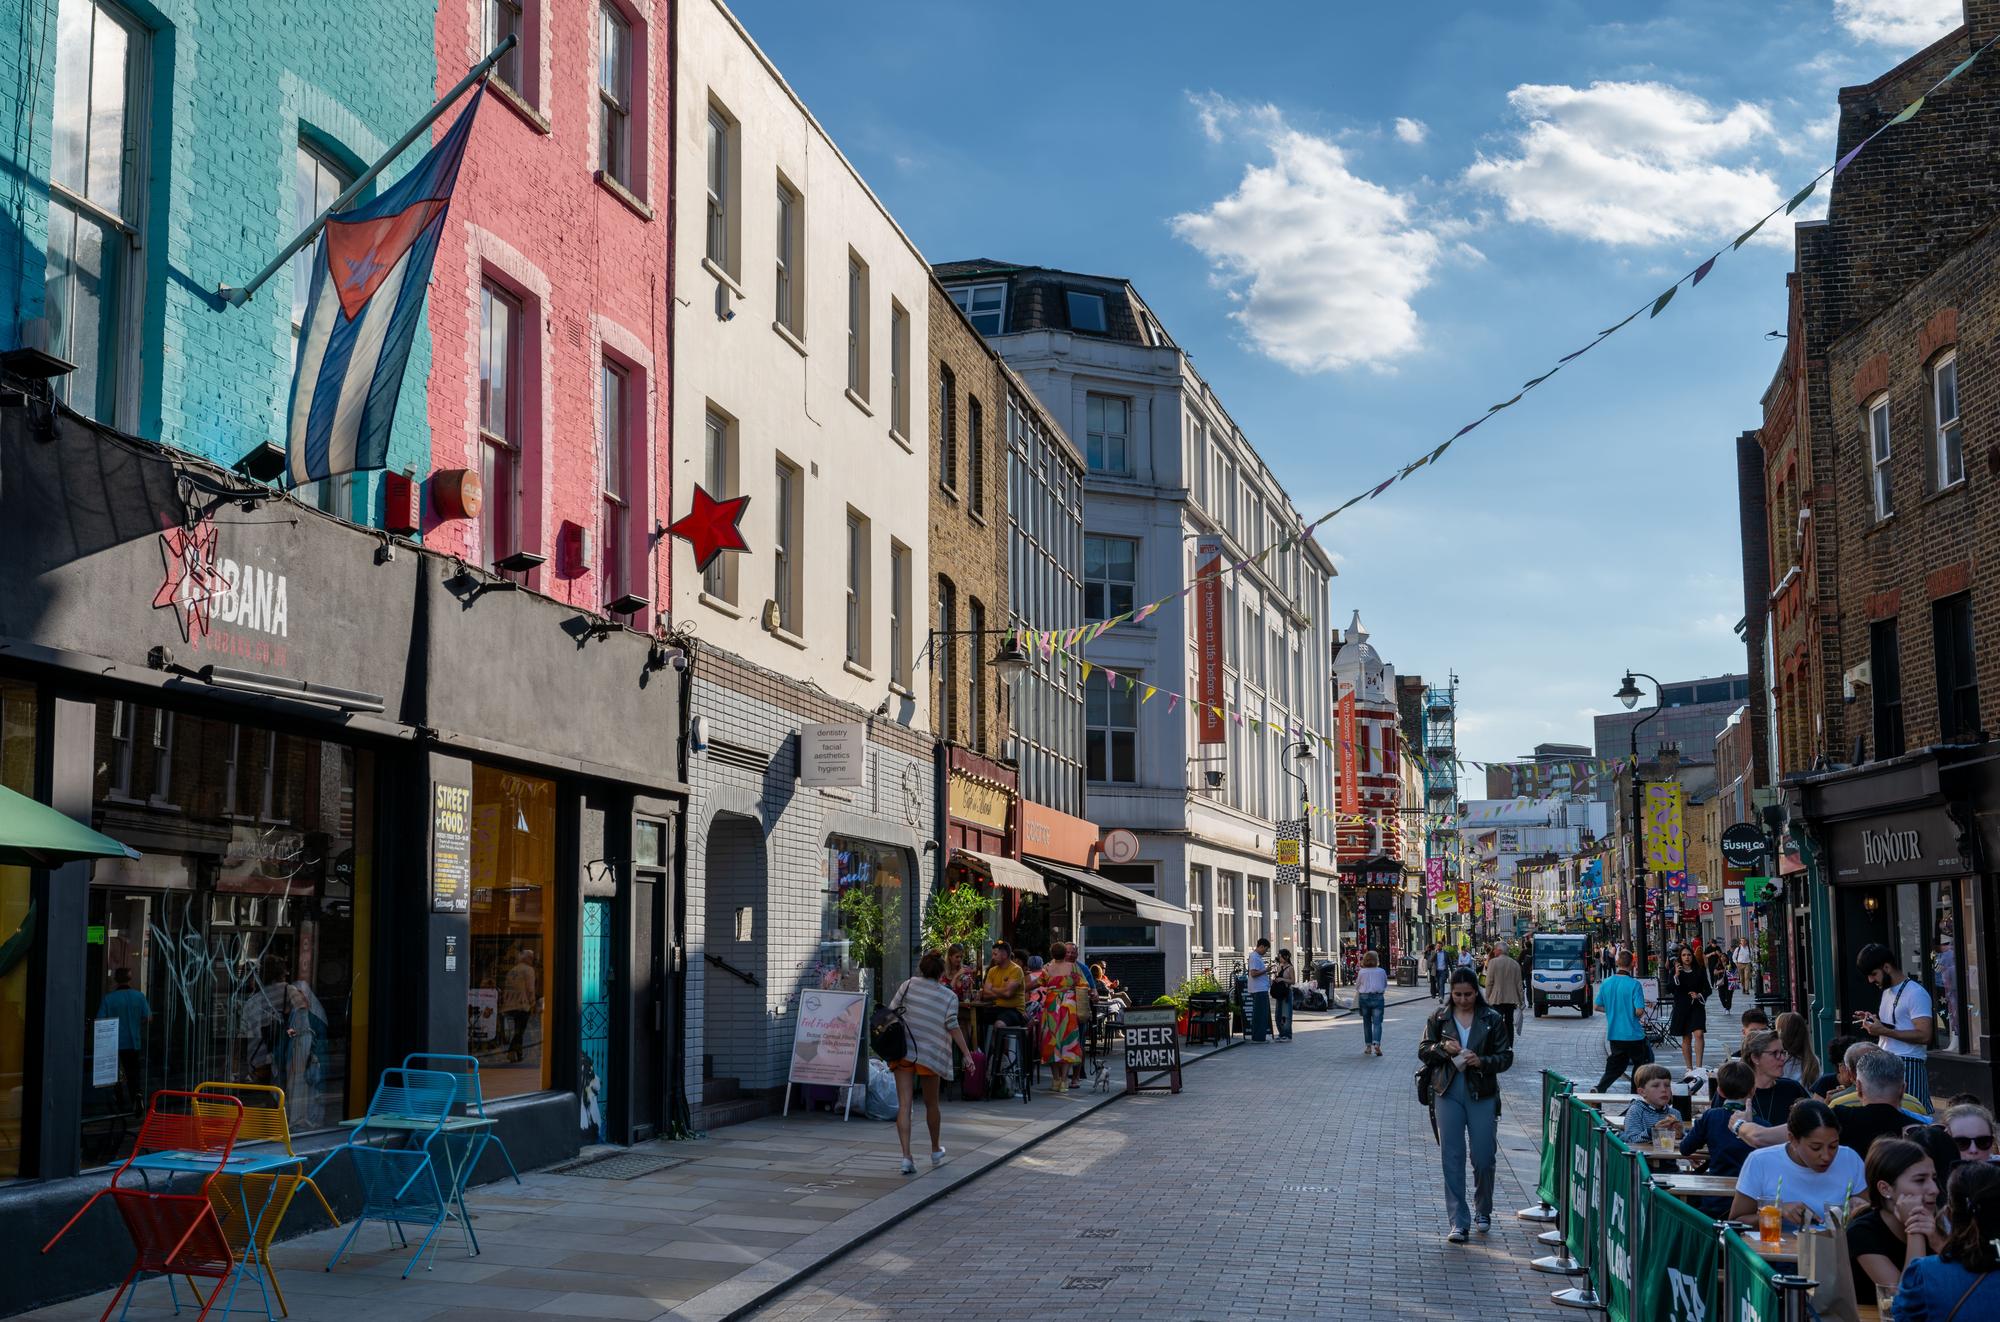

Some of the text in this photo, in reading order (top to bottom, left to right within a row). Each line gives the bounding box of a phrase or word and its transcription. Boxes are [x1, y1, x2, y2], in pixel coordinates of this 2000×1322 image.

[182, 547, 288, 638] CUBANA
[1204, 591, 1214, 629] believe
[1206, 631, 1215, 642] in
[1206, 644, 1216, 660] life
[1206, 661, 1217, 696] before
[1367, 677, 1377, 686] 34
[1207, 699, 1218, 729] death
[1343, 701, 1351, 714] We
[816, 729, 848, 738] dentistry
[1343, 715, 1352, 740] believe
[814, 751, 850, 760] aesthetics
[822, 743, 842, 751] facial
[817, 765, 847, 774] hygiene
[1345, 761, 1353, 780] before
[437, 784, 470, 813] STREET
[1345, 784, 1354, 806] death
[441, 810, 464, 834] FOOD
[1112, 834, 1130, 858] b
[1723, 842, 1751, 850] SUSHI
[455, 898, 468, 910] ONLY
[1126, 1027, 1174, 1046] BEER
[1127, 1048, 1176, 1068] GARDEN
